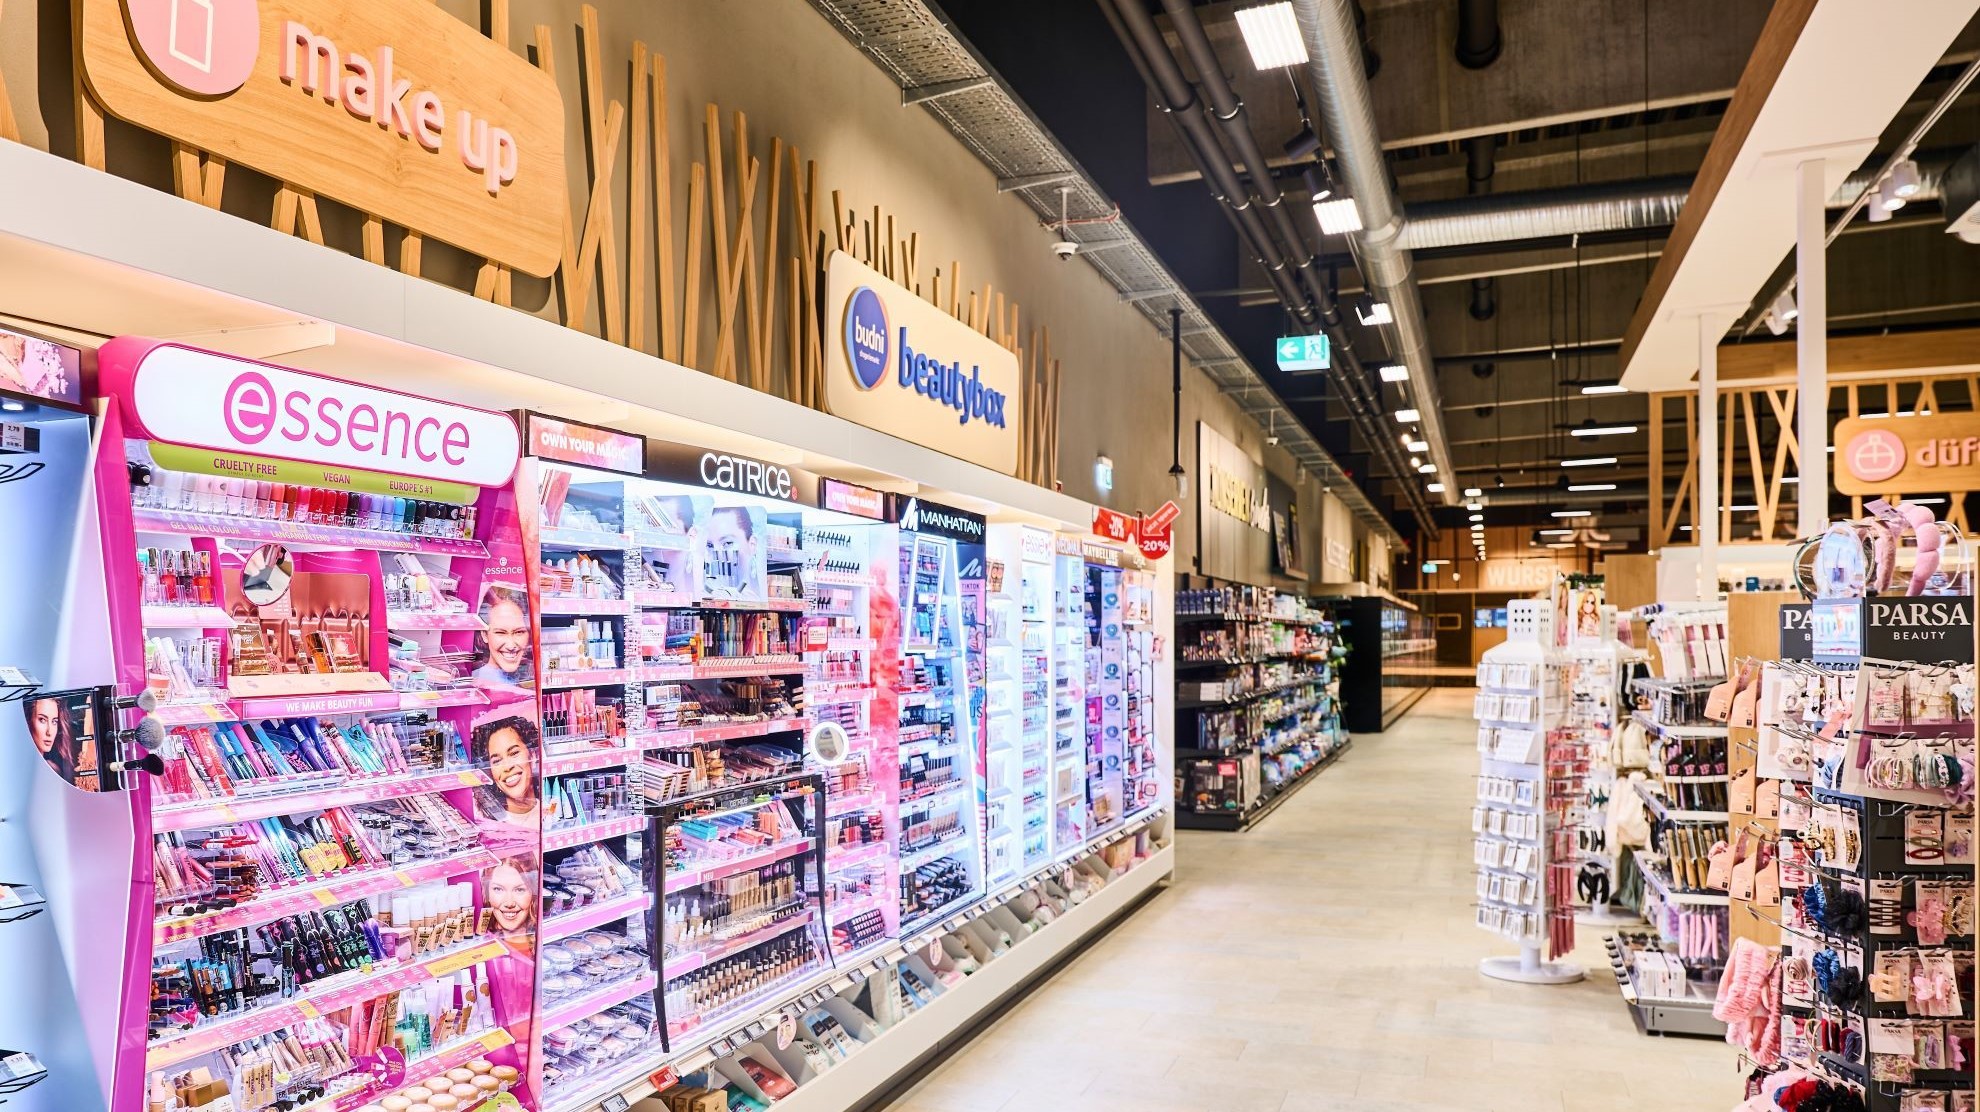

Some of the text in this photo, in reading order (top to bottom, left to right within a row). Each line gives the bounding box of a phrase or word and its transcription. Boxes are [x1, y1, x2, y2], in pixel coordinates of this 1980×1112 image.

[279, 19, 519, 195] make up
[855, 315, 885, 354] budni
[899, 326, 1006, 429] beautybox
[224, 371, 470, 466] essence
[541, 432, 567, 449] OWN
[568, 437, 595, 454] YOUR
[1915, 436, 1980, 468] düf
[213, 457, 254, 473] CRUELTY
[255, 463, 277, 476] FREE
[323, 471, 351, 485] VEGAN
[920, 509, 982, 535] MANHATTAN
[1138, 540, 1170, 551] -20%
[485, 564, 523, 576] essence
[1783, 609, 1813, 630] PA
[1870, 602, 1971, 627] PARSA
[1893, 631, 1946, 641] BEAUTY
[286, 697, 373, 713] WE MAKE BEAUTY FUN
